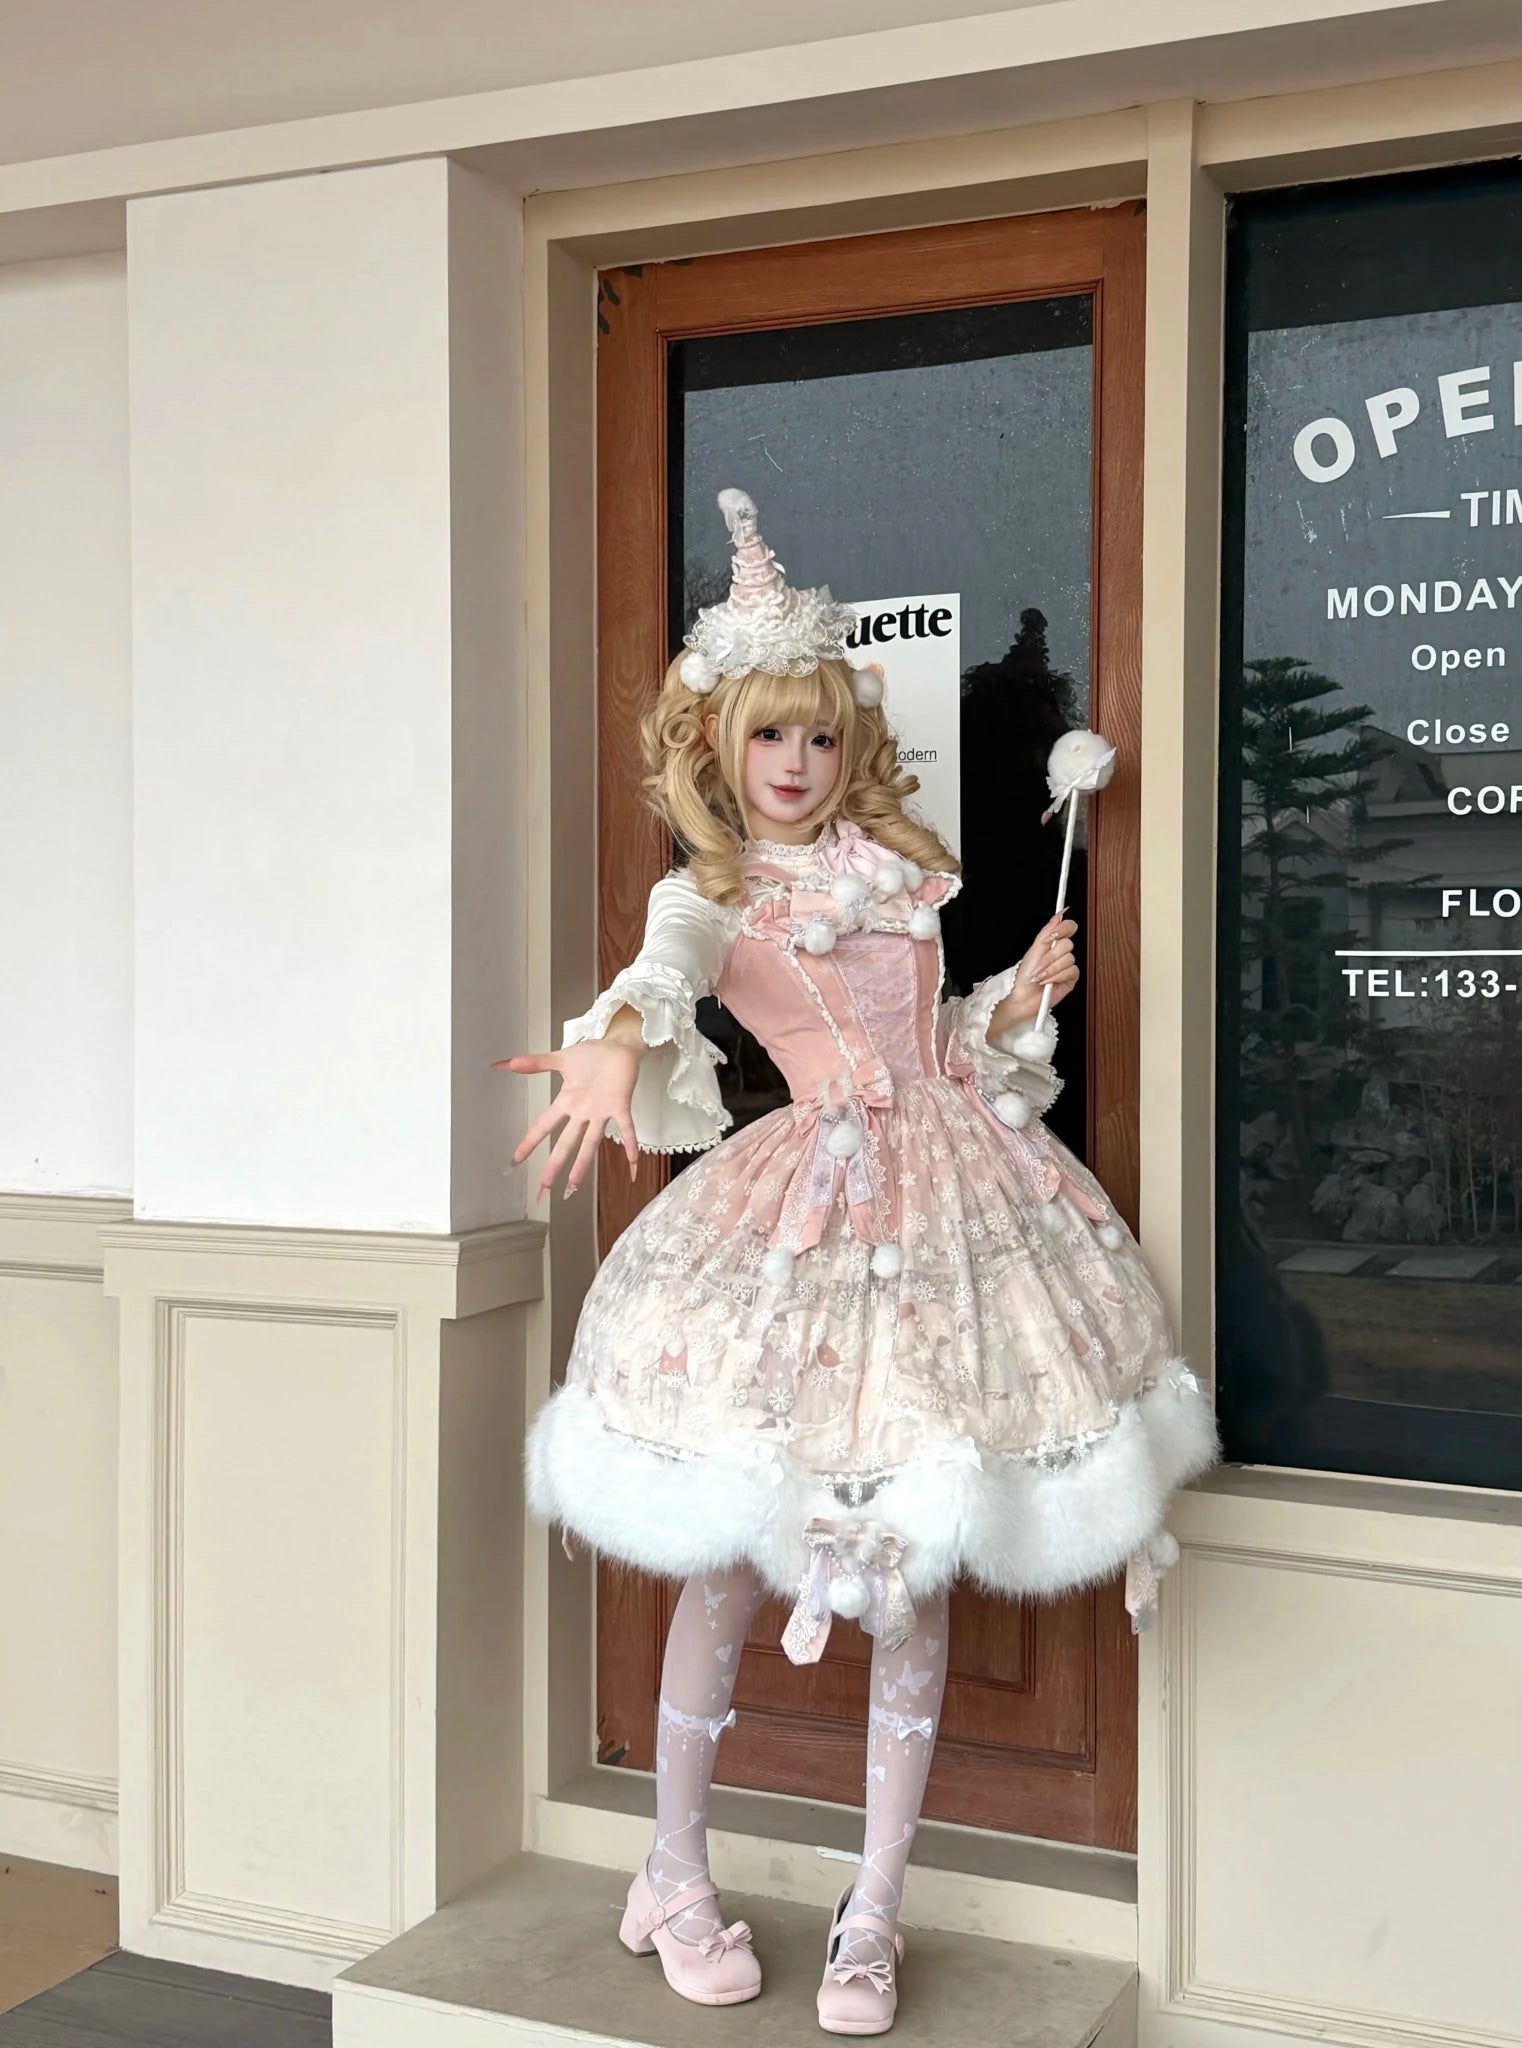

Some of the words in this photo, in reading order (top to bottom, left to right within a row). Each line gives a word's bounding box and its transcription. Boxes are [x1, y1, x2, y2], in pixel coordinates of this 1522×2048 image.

[1327, 575, 1522, 620] MONDAY
[1411, 644, 1506, 676] Open
[1406, 718, 1510, 746] Close
[1442, 888, 1522, 918] FLO
